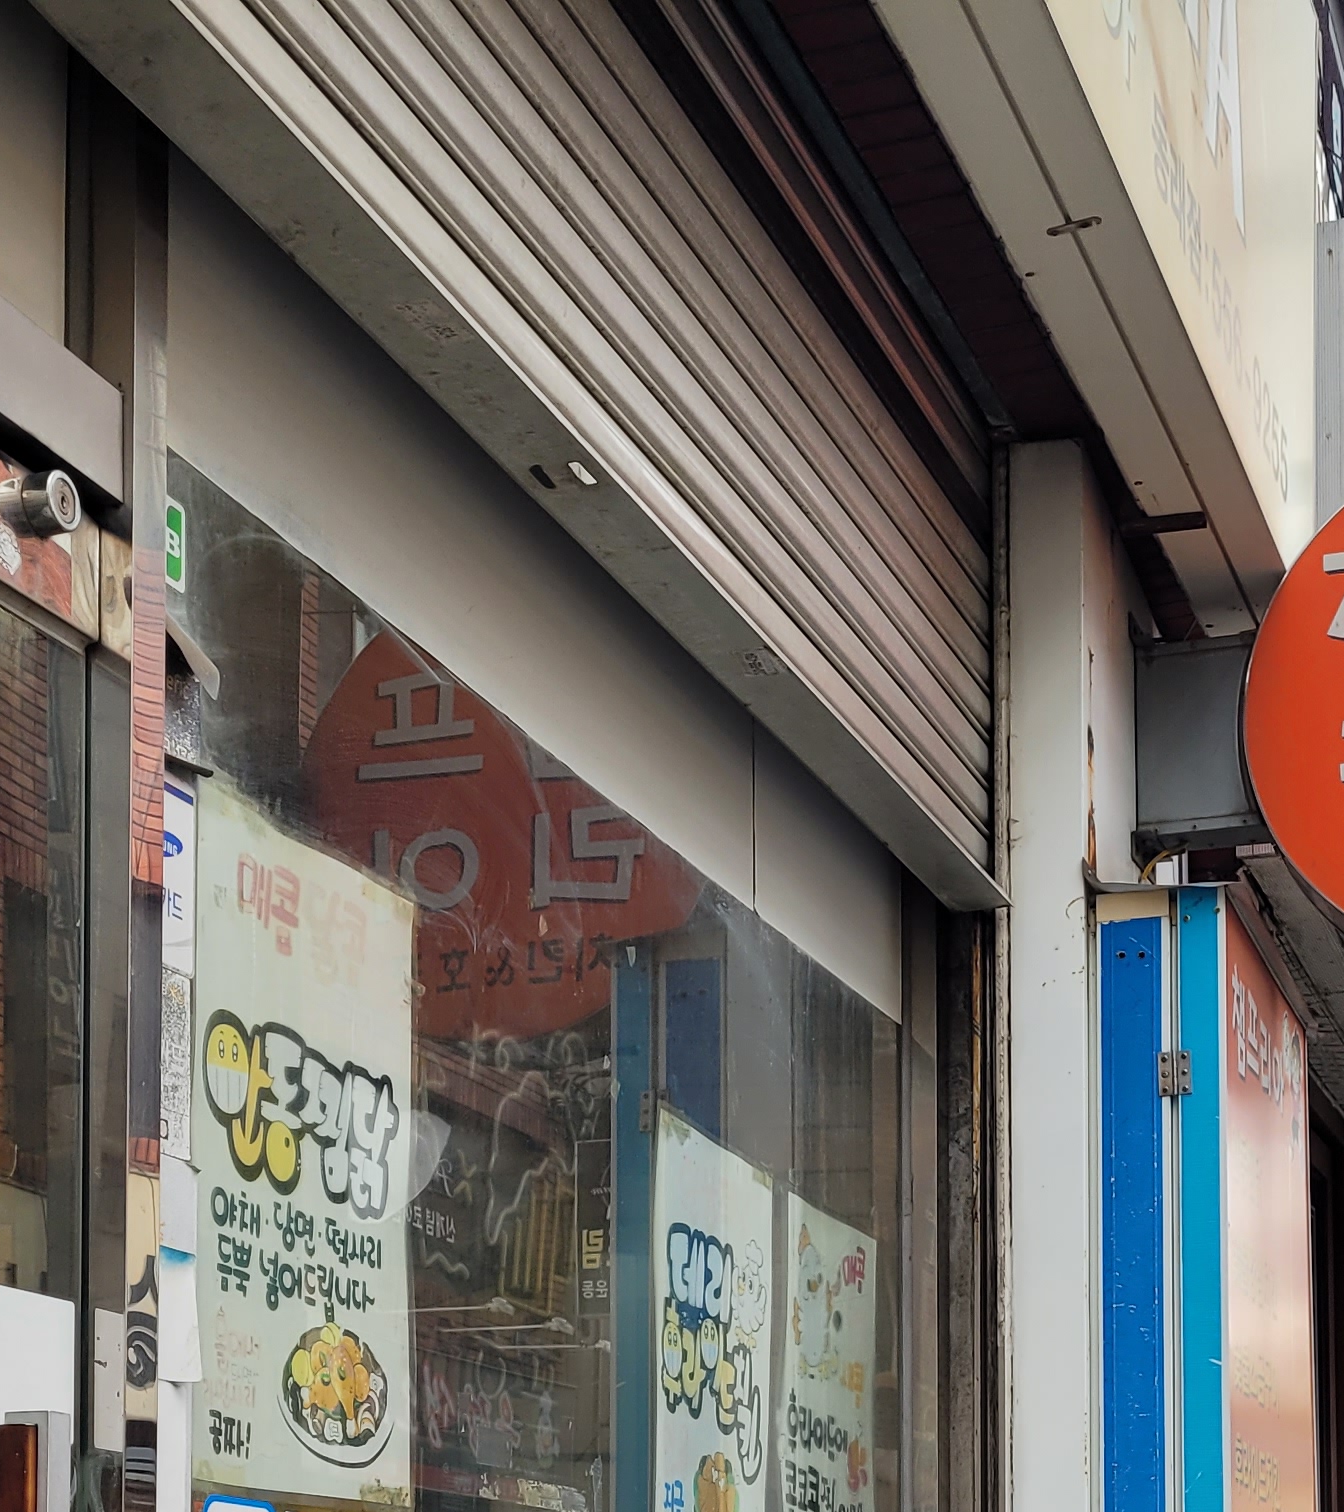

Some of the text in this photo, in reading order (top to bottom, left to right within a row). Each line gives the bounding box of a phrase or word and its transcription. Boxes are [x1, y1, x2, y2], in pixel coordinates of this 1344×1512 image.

[1231, 962, 1284, 1115] 챔프리아
[202, 1008, 400, 1221] 안동찜닭
[210, 1186, 383, 1271] 야채 당면 떡사리
[216, 1233, 376, 1323] 듬뿍 넣어드립니다
